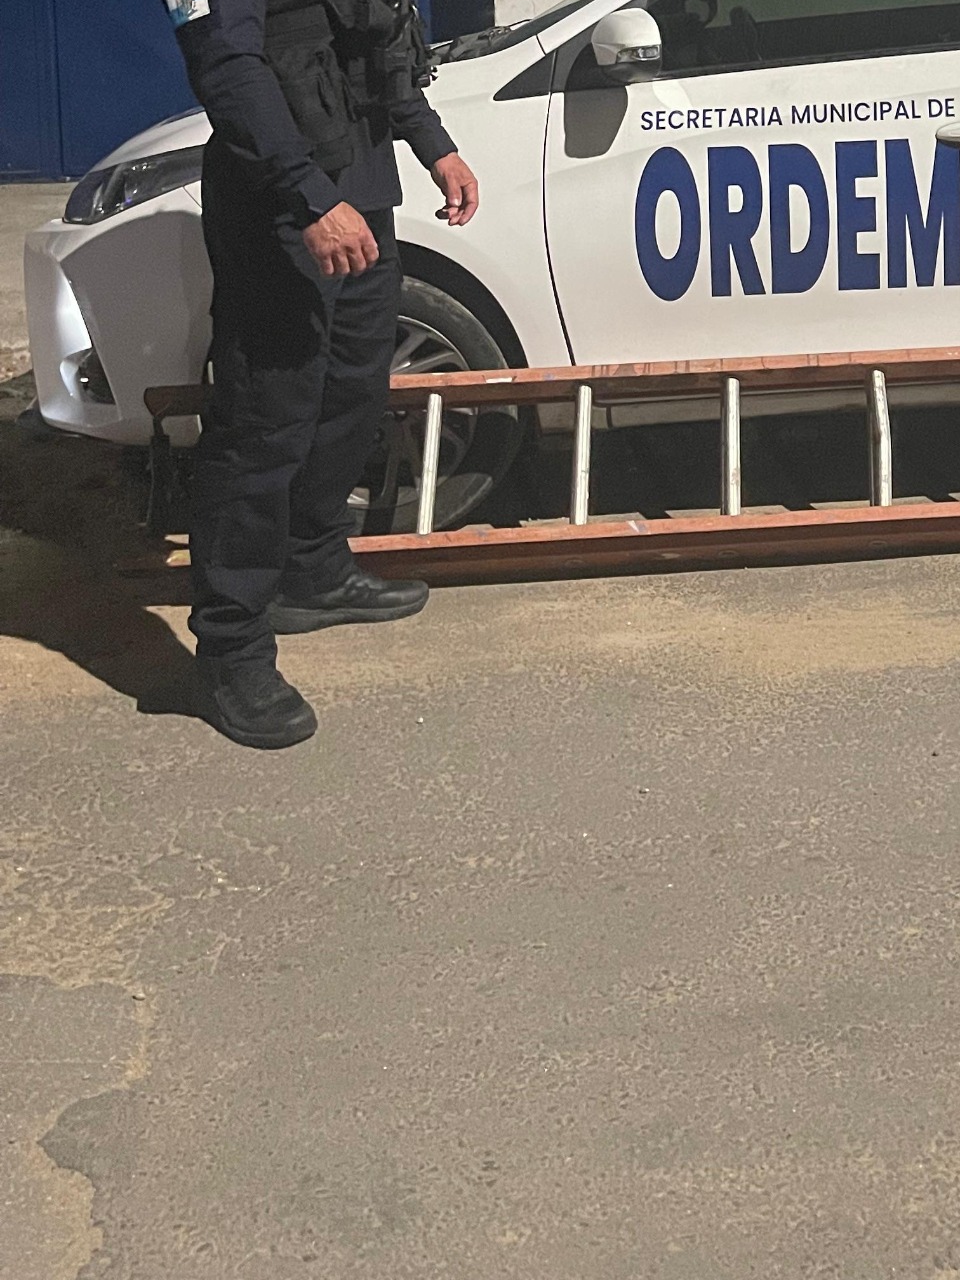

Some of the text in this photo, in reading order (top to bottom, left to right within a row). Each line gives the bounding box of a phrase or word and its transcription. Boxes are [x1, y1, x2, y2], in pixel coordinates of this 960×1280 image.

[640, 98, 956, 130] SECRETARIA MUNICIPAL DE
